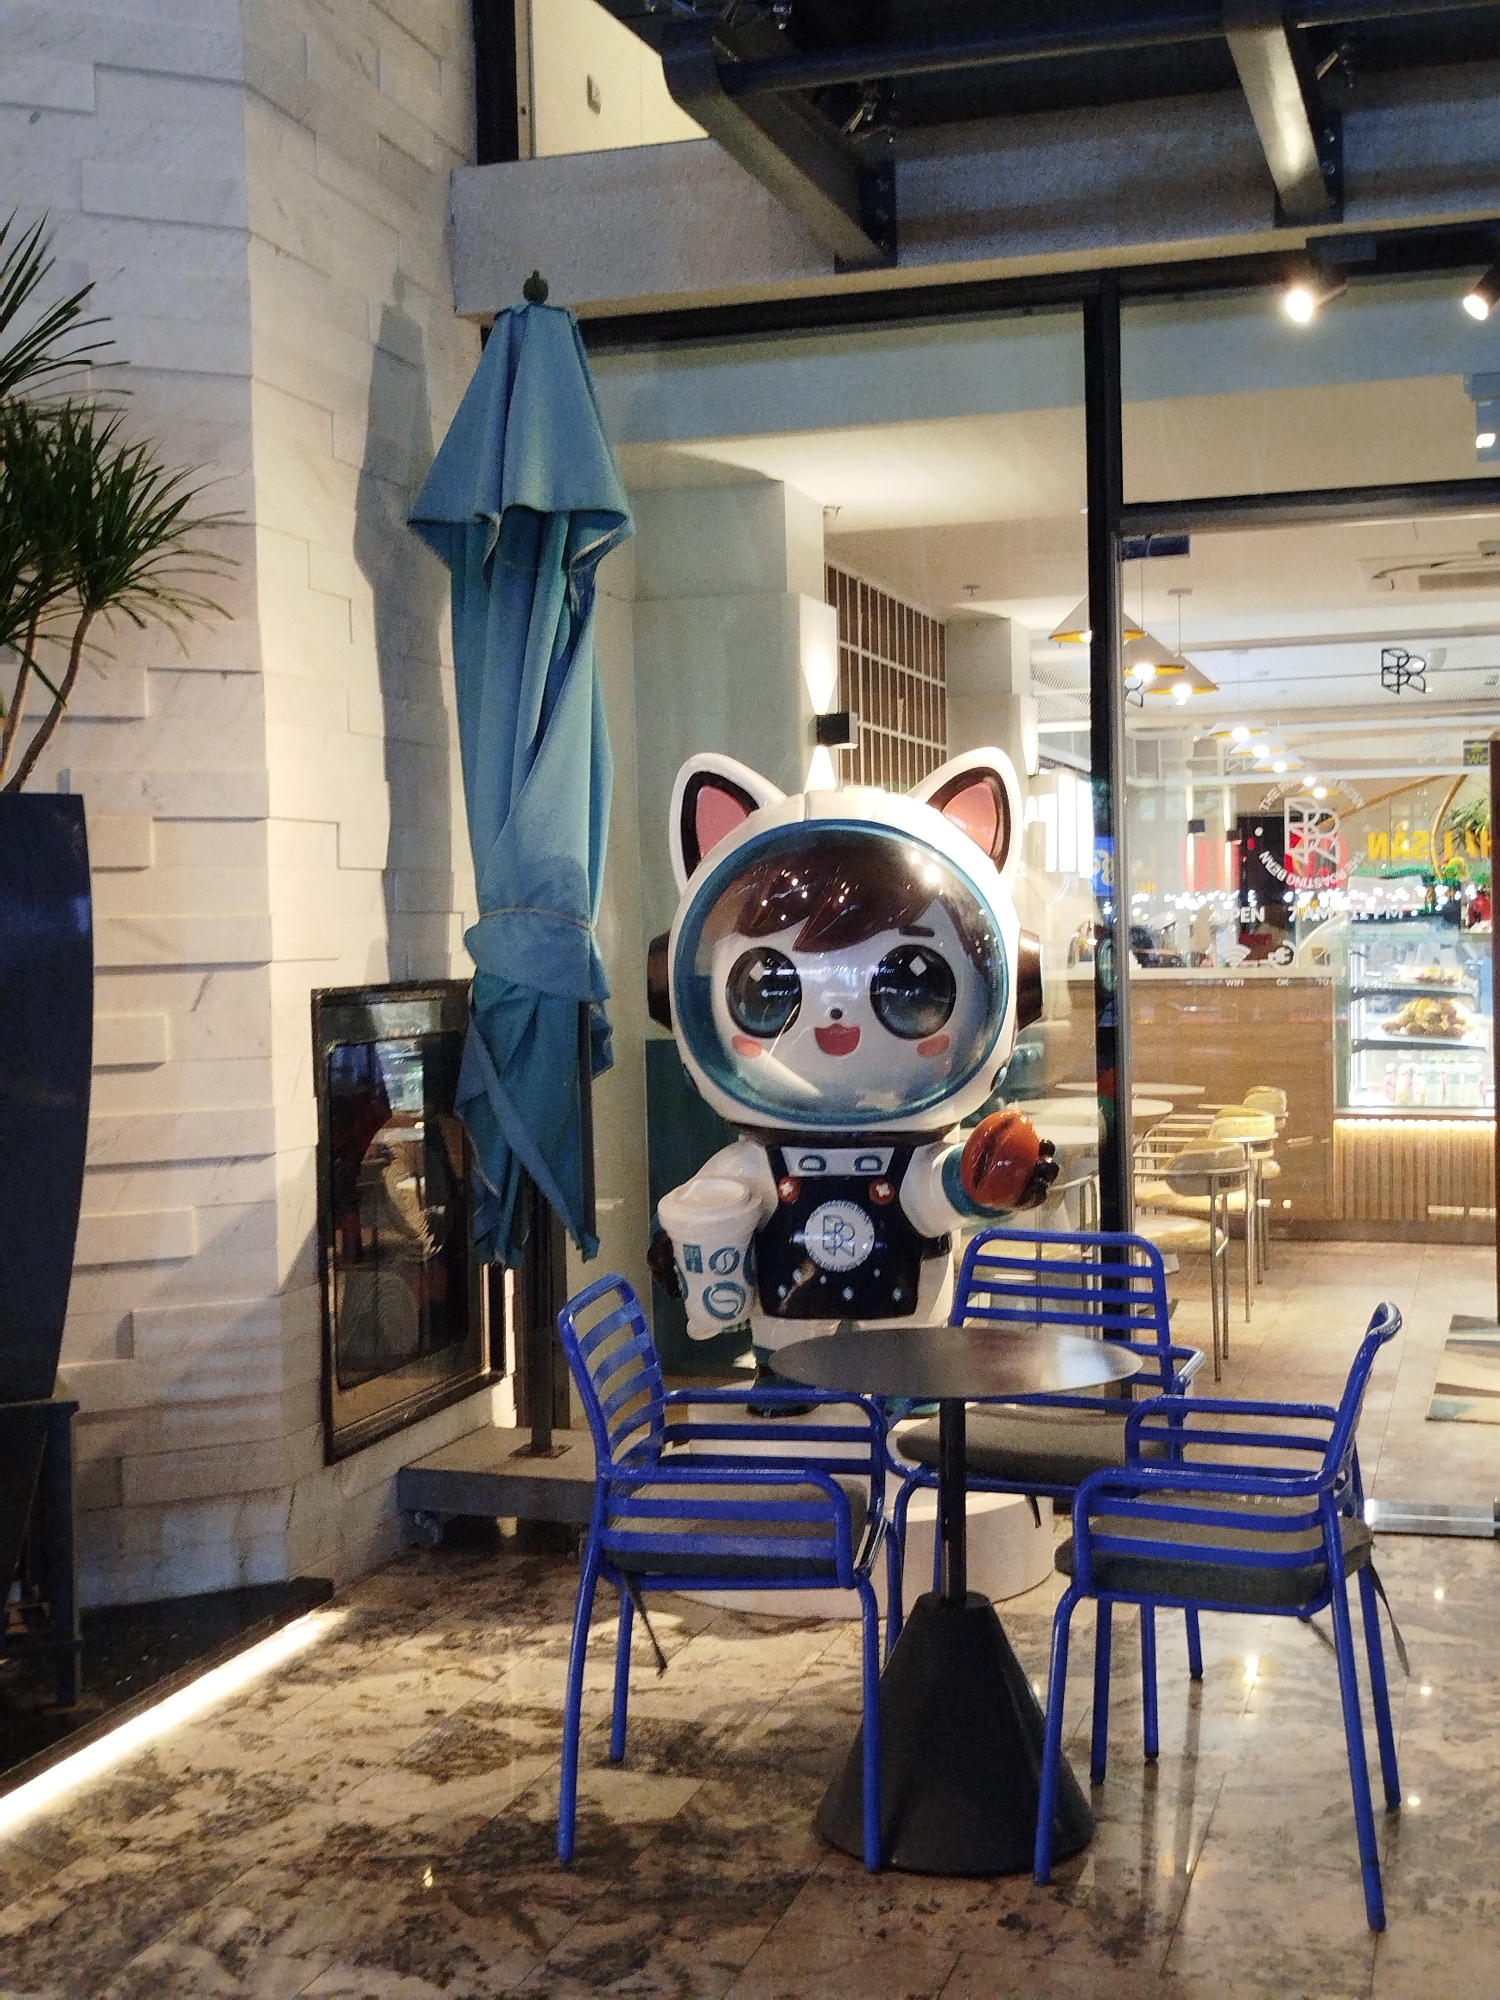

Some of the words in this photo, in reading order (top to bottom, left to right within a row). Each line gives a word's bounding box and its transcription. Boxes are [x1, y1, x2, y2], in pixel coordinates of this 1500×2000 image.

[1259, 850, 1288, 882] BEAN
[1287, 905, 1298, 922] 7
[1301, 904, 1332, 922] AM
[1373, 904, 1404, 920] PM
